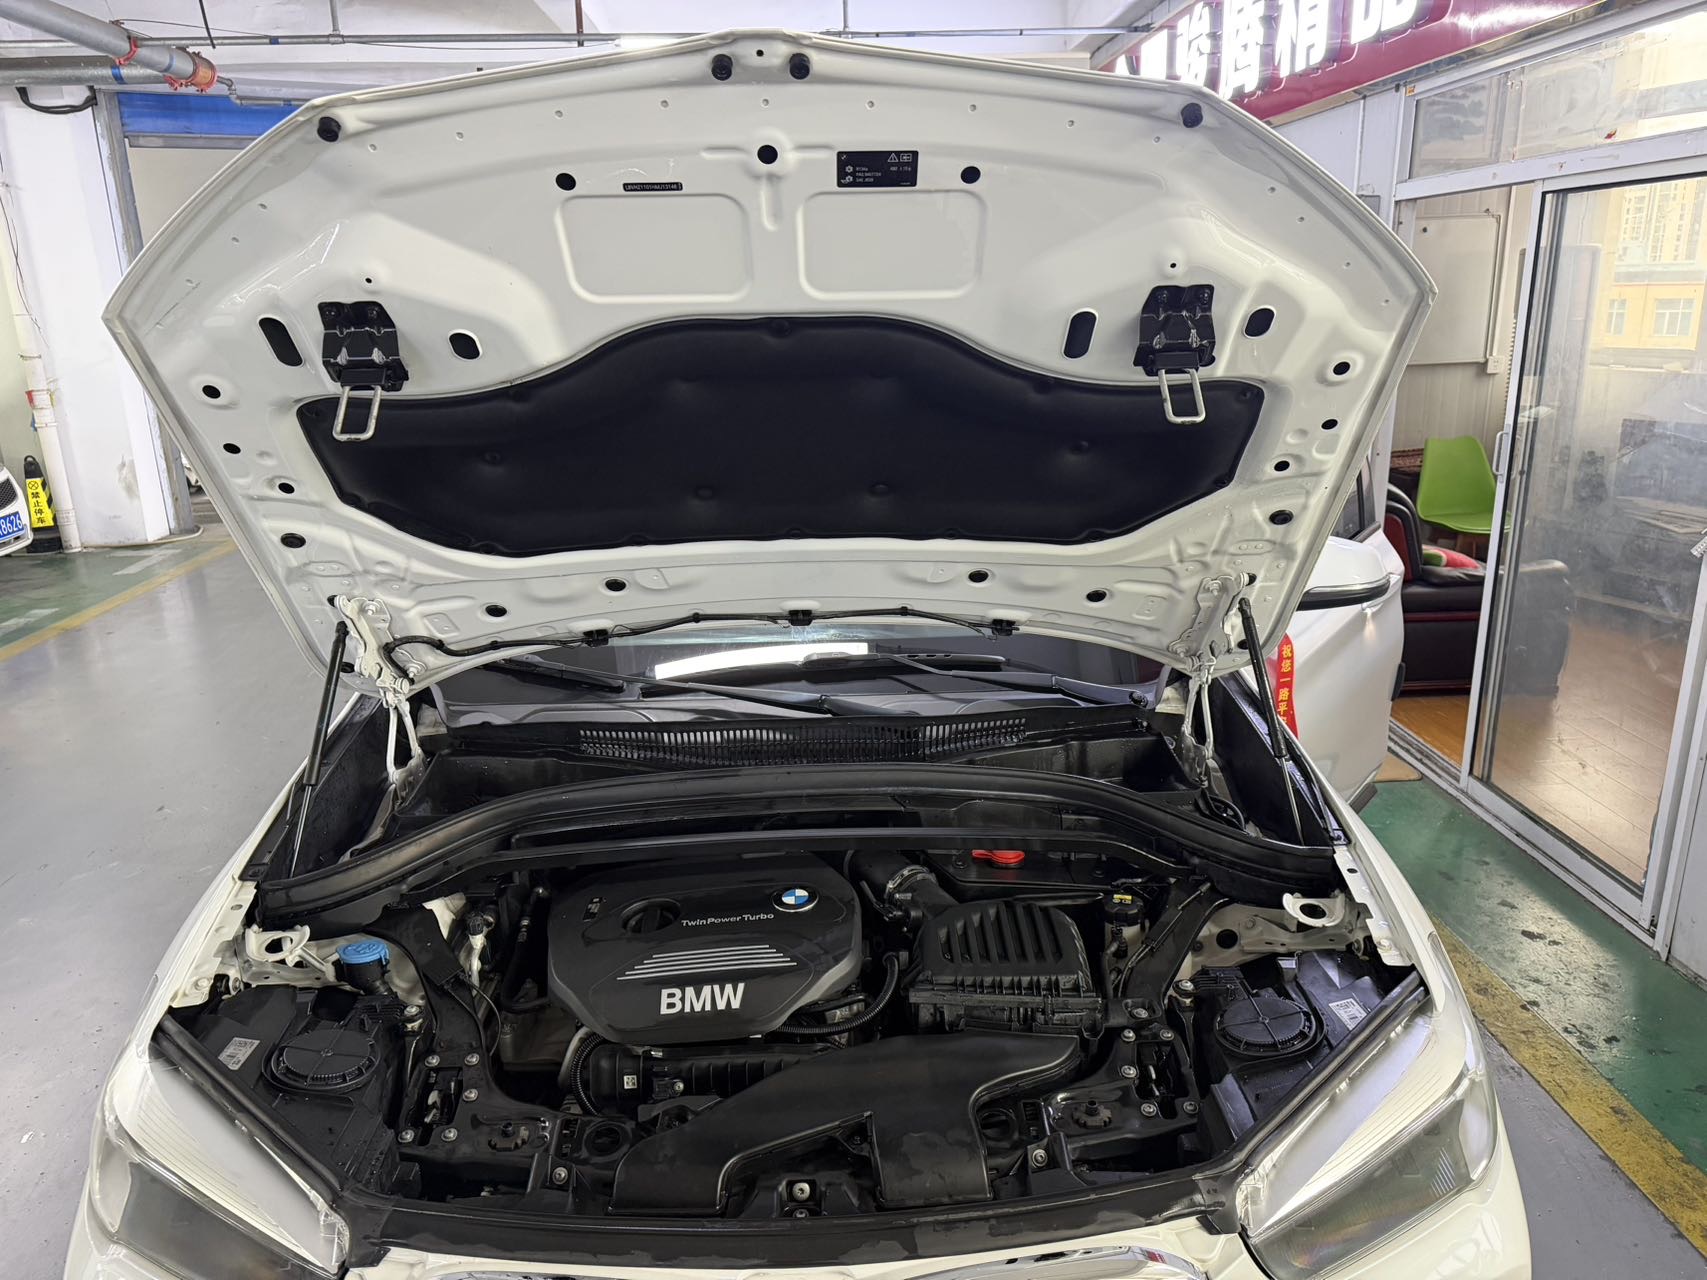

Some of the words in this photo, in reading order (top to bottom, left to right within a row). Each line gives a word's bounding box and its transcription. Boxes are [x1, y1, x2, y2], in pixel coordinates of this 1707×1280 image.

[30, 491, 46, 524] 禁止停车
[742, 912, 775, 922] Turbo
[660, 982, 745, 1015] BMW
